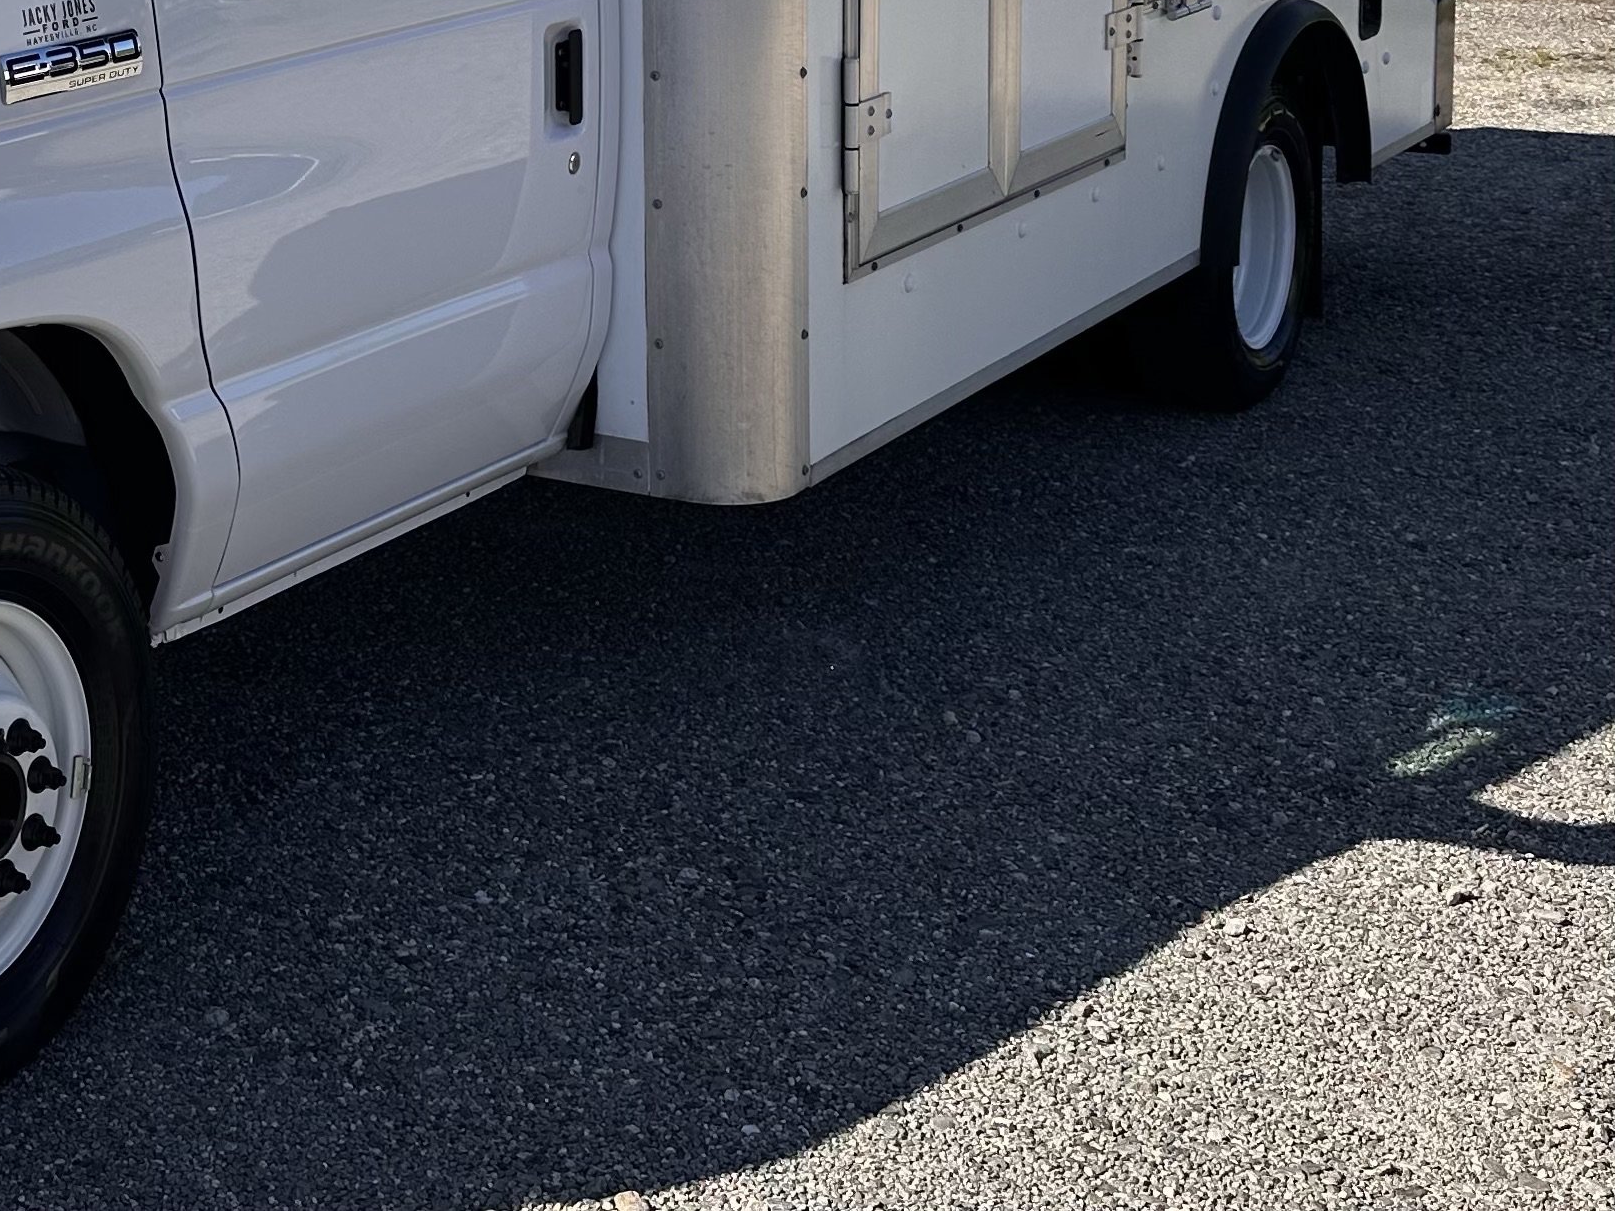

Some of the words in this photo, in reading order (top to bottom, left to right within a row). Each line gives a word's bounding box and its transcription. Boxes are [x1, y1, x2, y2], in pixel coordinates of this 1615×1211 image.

[22, 2, 56, 28] JACKY
[42, 17, 79, 33] FORD
[86, 24, 98, 33] NC
[68, 74, 107, 89] SUPER
[109, 66, 139, 79] DUTY
